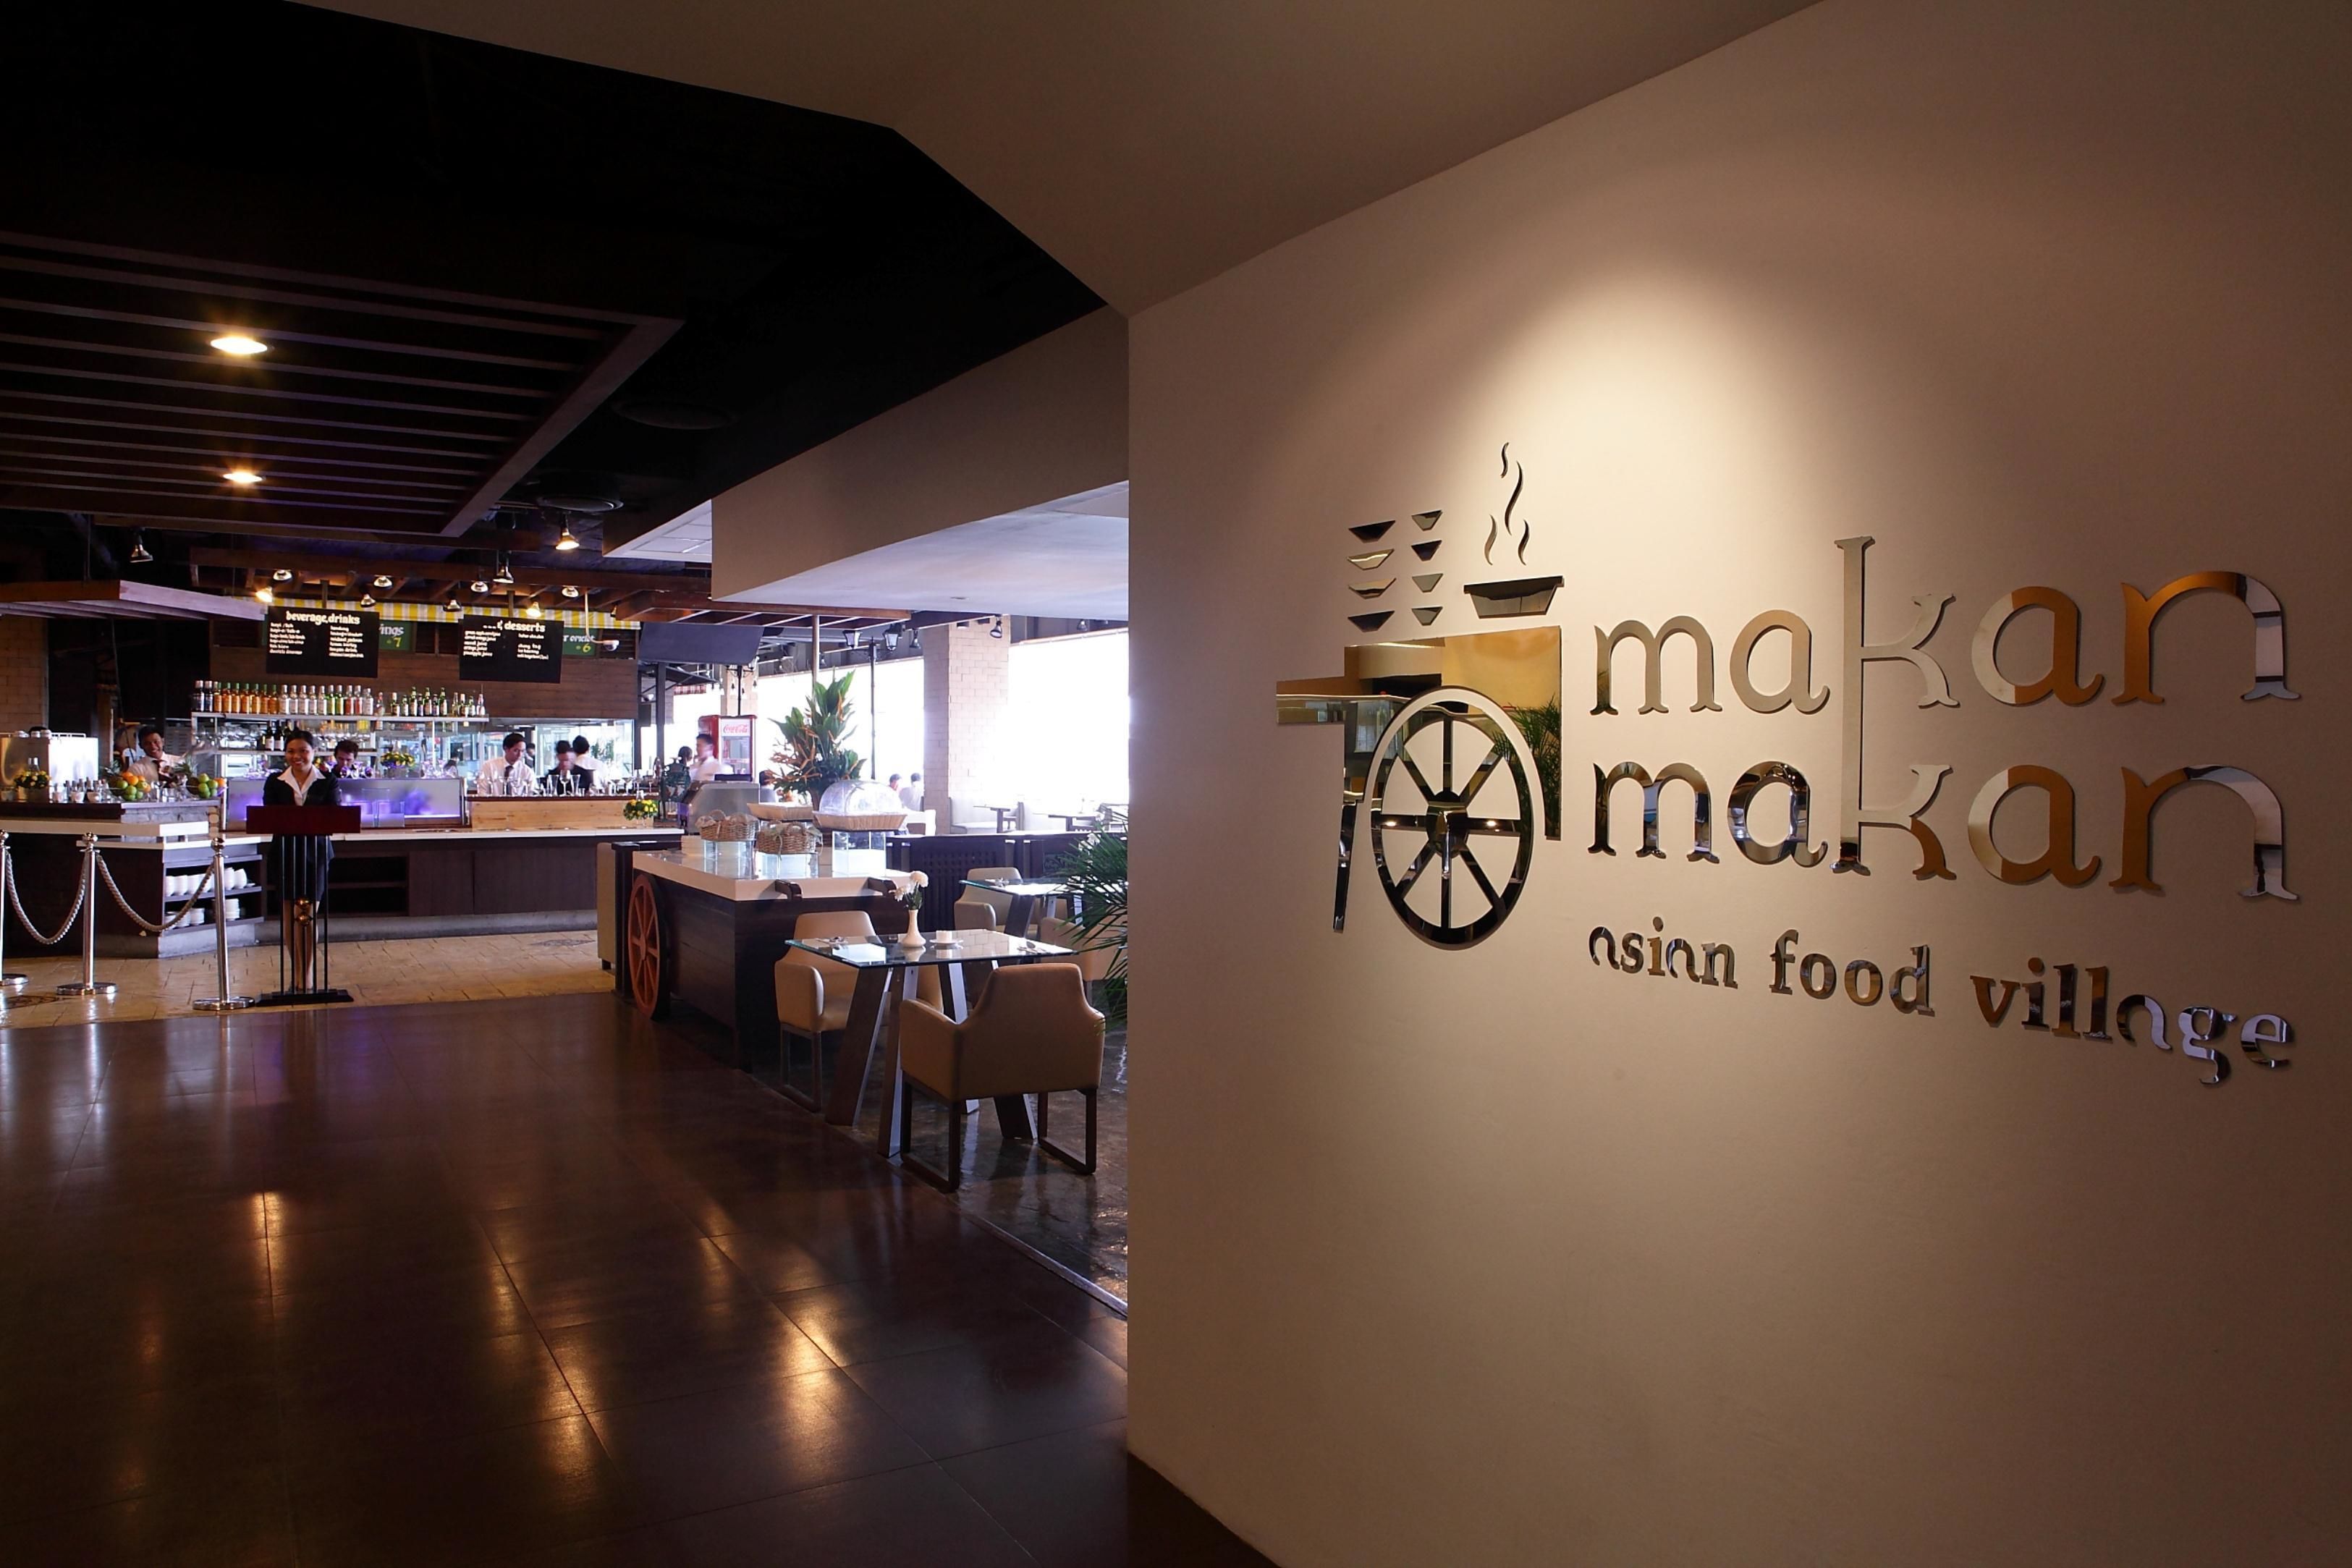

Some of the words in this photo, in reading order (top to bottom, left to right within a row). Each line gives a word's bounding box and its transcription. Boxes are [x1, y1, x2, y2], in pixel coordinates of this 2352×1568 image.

[378, 623, 405, 637] ings
[504, 621, 546, 632] desserts
[583, 643, 591, 653] 6
[1590, 536, 2300, 714] makan
[1588, 760, 2300, 902] makan
[1769, 928, 1935, 1017] food
[1969, 957, 2293, 1085] village
